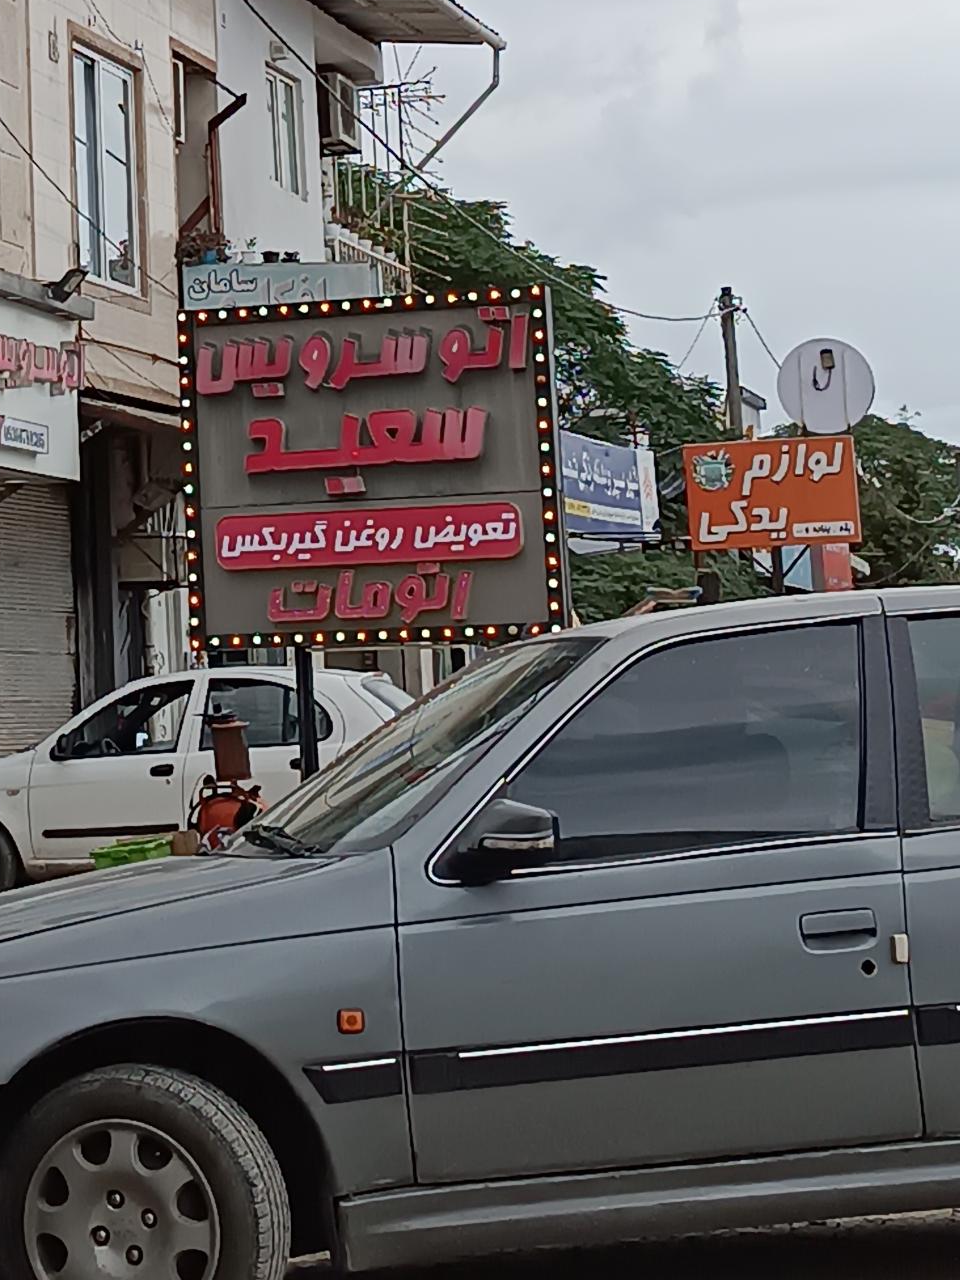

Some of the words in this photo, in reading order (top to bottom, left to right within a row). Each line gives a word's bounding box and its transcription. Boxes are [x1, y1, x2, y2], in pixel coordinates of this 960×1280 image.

[187, 268, 258, 301] سامان
[195, 330, 431, 399] سرویس
[439, 305, 529, 383] اتو
[243, 405, 486, 496] سعید
[741, 440, 844, 496] لوازم
[220, 520, 328, 561] گیربکس
[334, 519, 404, 553] روغن
[414, 512, 517, 551] تعویض
[698, 500, 788, 542] یدکی
[267, 562, 473, 624] اتومات
